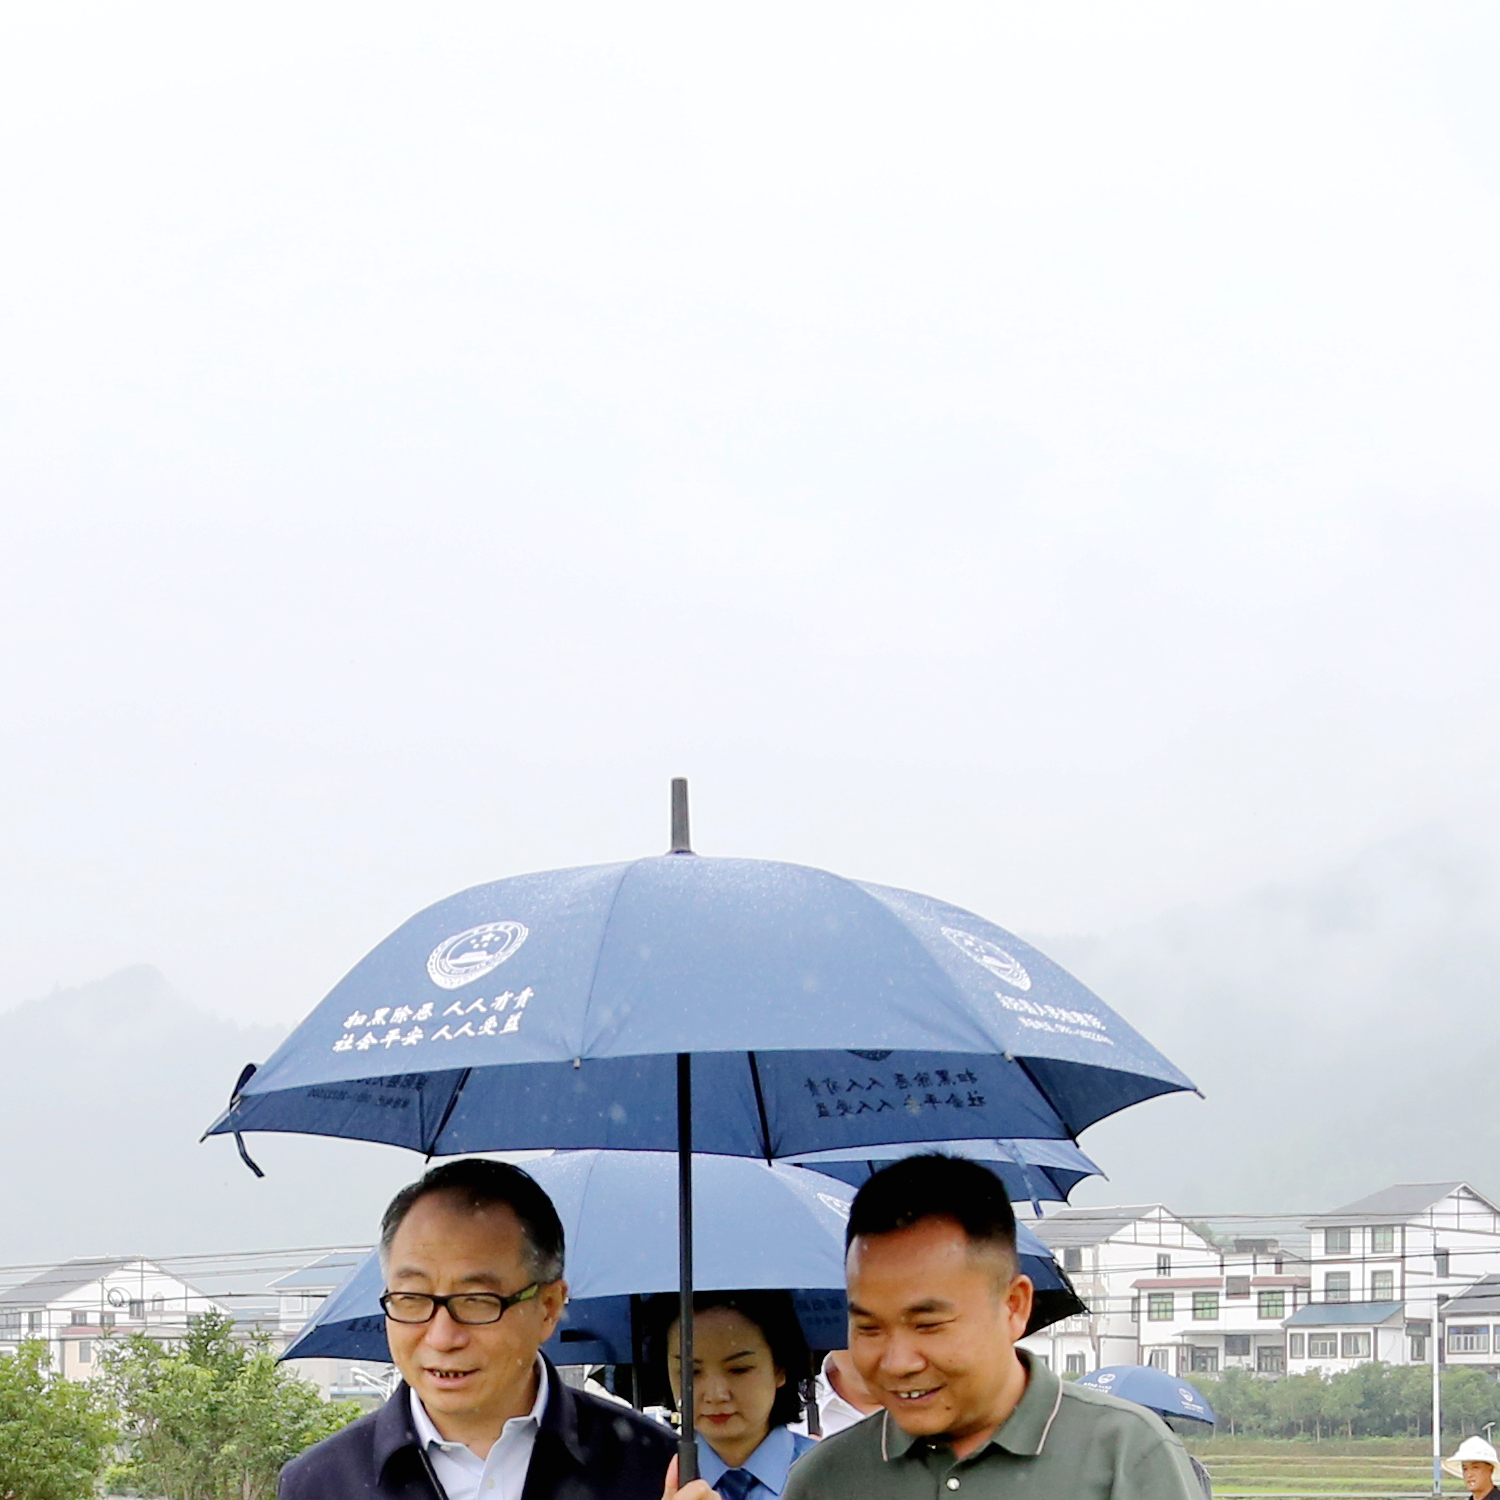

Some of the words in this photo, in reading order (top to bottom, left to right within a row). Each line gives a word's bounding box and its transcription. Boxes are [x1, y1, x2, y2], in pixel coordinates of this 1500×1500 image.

[343, 1001, 434, 1029] 扫黑除恶
[443, 986, 534, 1016] 人人有责
[332, 1026, 424, 1053] 社会平安
[431, 1011, 523, 1041] 人人受益
